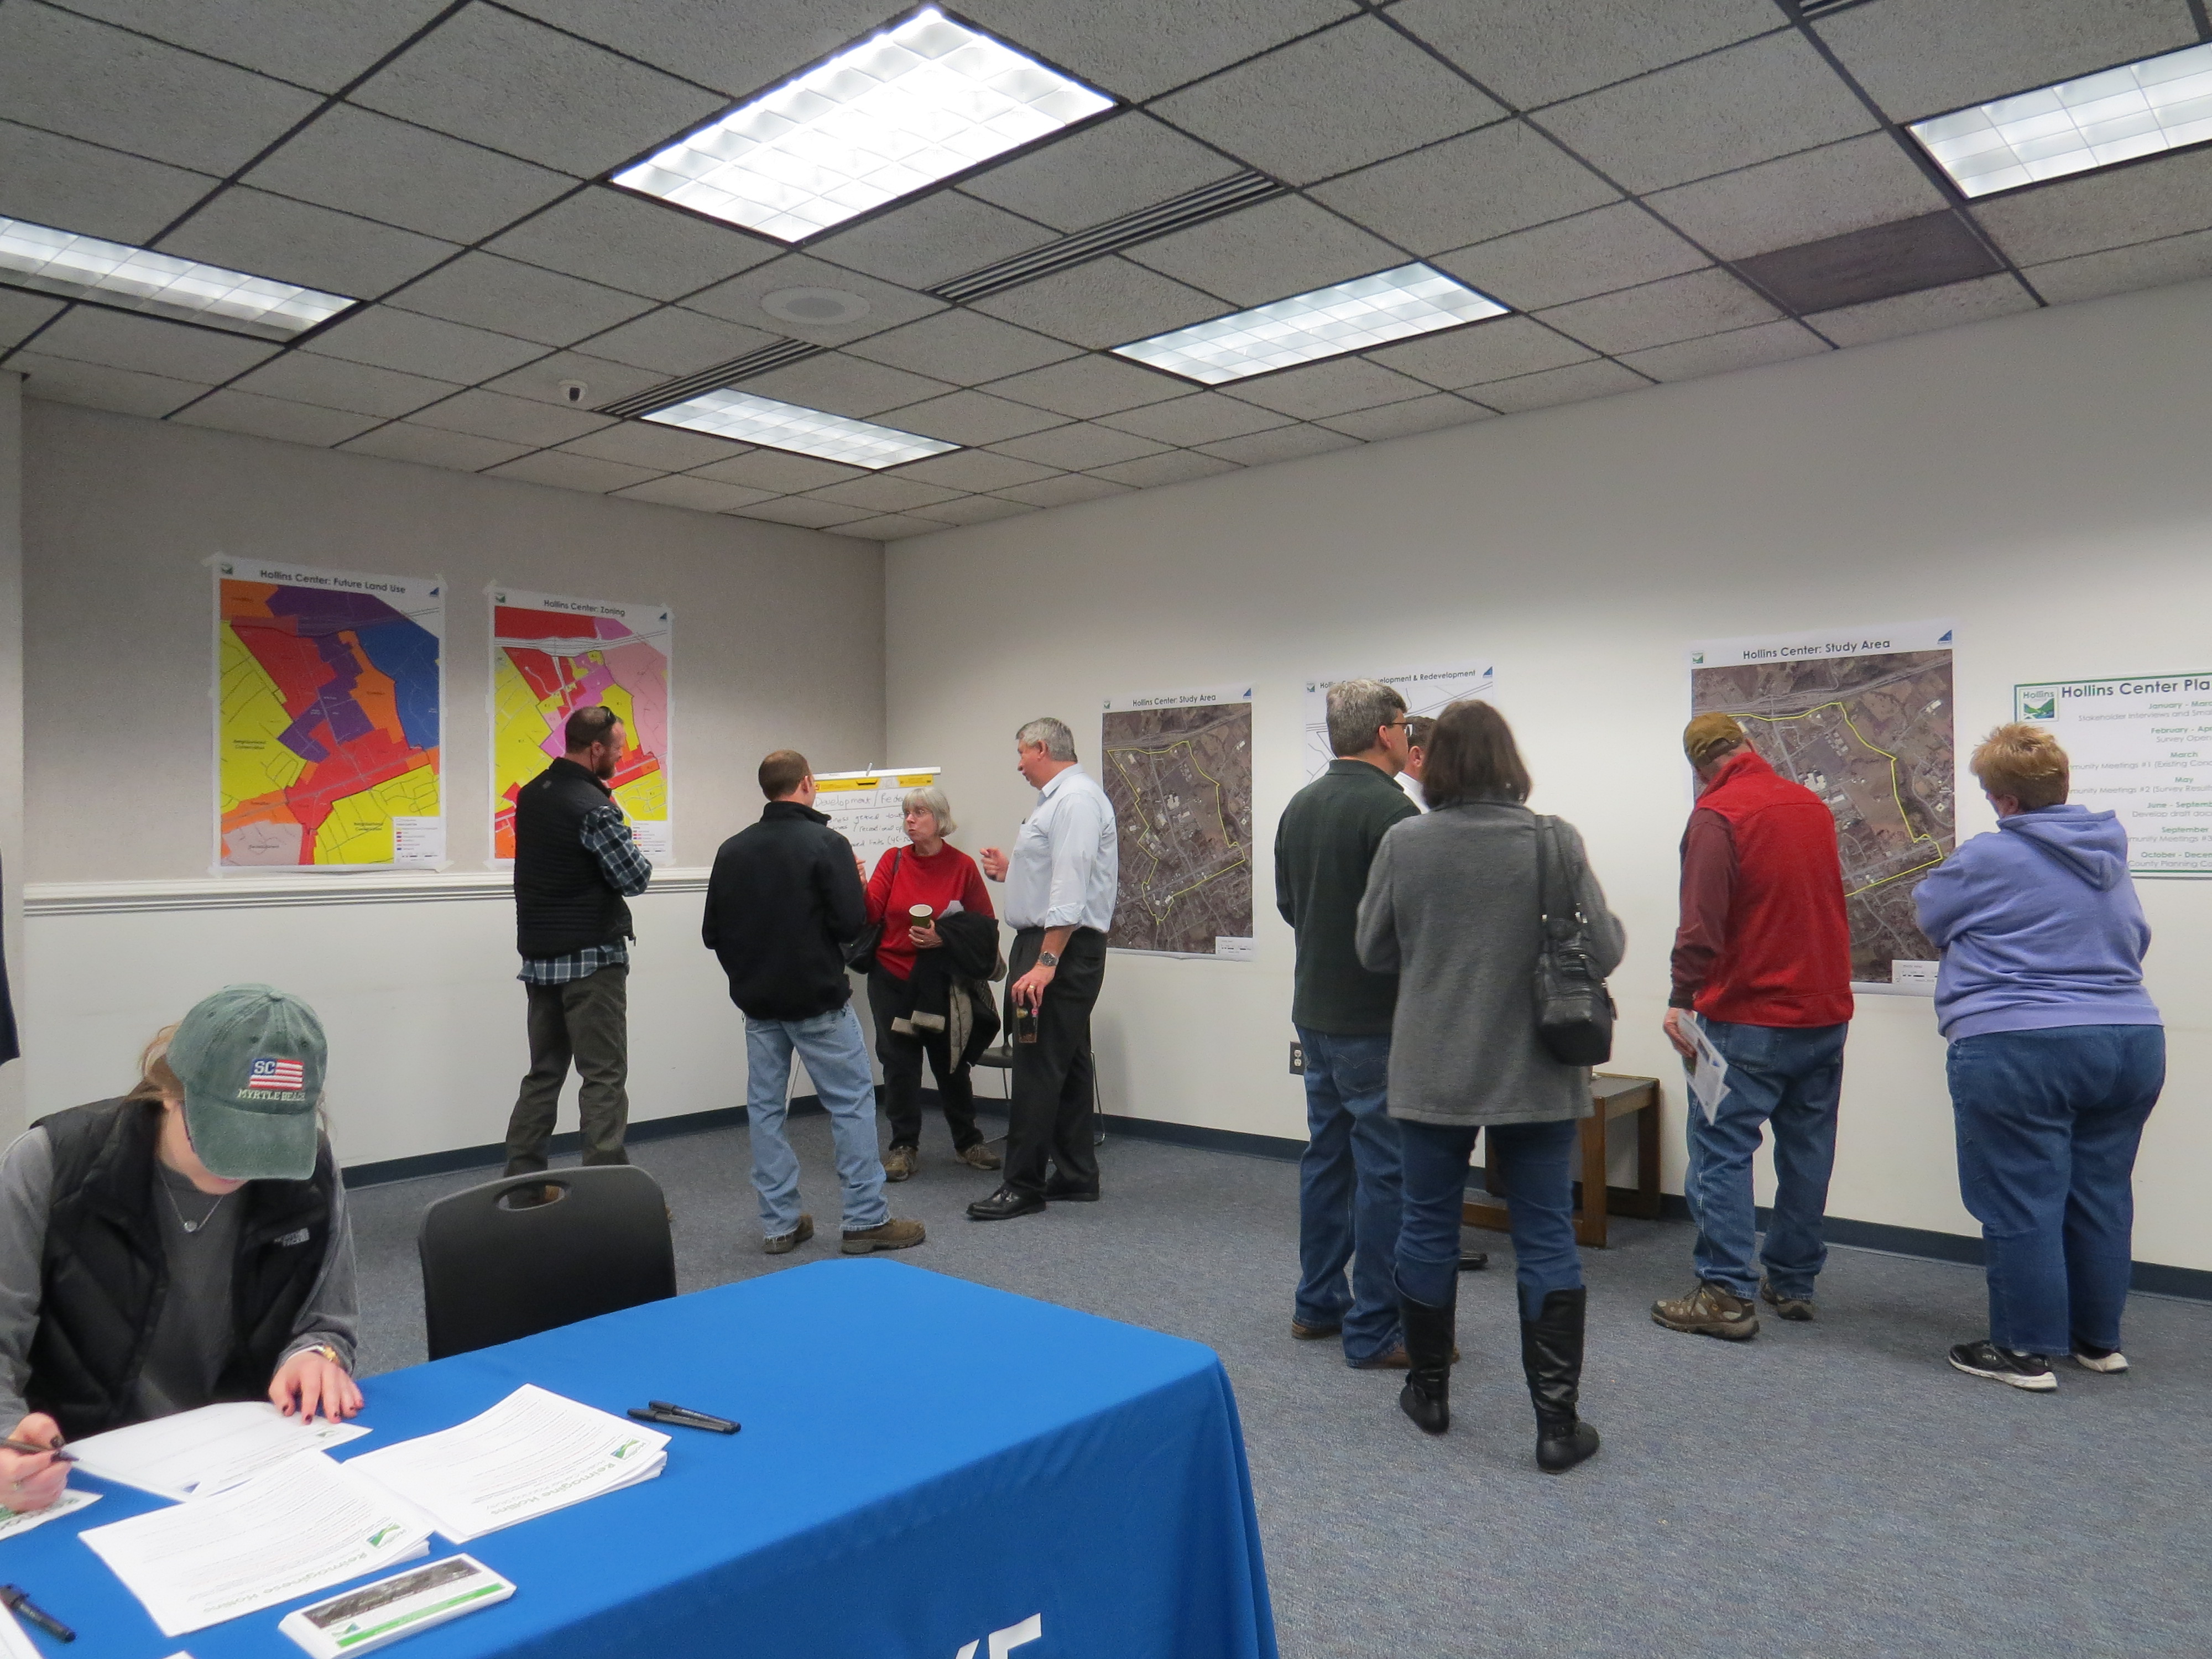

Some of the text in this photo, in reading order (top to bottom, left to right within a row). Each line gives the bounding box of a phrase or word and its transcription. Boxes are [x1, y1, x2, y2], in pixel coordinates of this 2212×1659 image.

[260, 570, 406, 593] Hollins Center: Future Land Use
[544, 600, 568, 609] Hollins
[601, 606, 625, 617] Zoning
[1743, 639, 1891, 660] Hollins Center: Study Area
[1420, 669, 1475, 681] Redevelopment
[2023, 690, 2054, 698] Hollins
[2062, 685, 2114, 698] Hollins
[2120, 681, 2178, 695] Center
[1133, 694, 1216, 707] Hollins Center: Study Area
[2154, 760, 2187, 769] (Existing
[2153, 785, 2183, 794] (Survey
[2161, 860, 2197, 868] Planning
[254, 1060, 275, 1074] SC
[237, 1088, 280, 1101] MYRTLE
